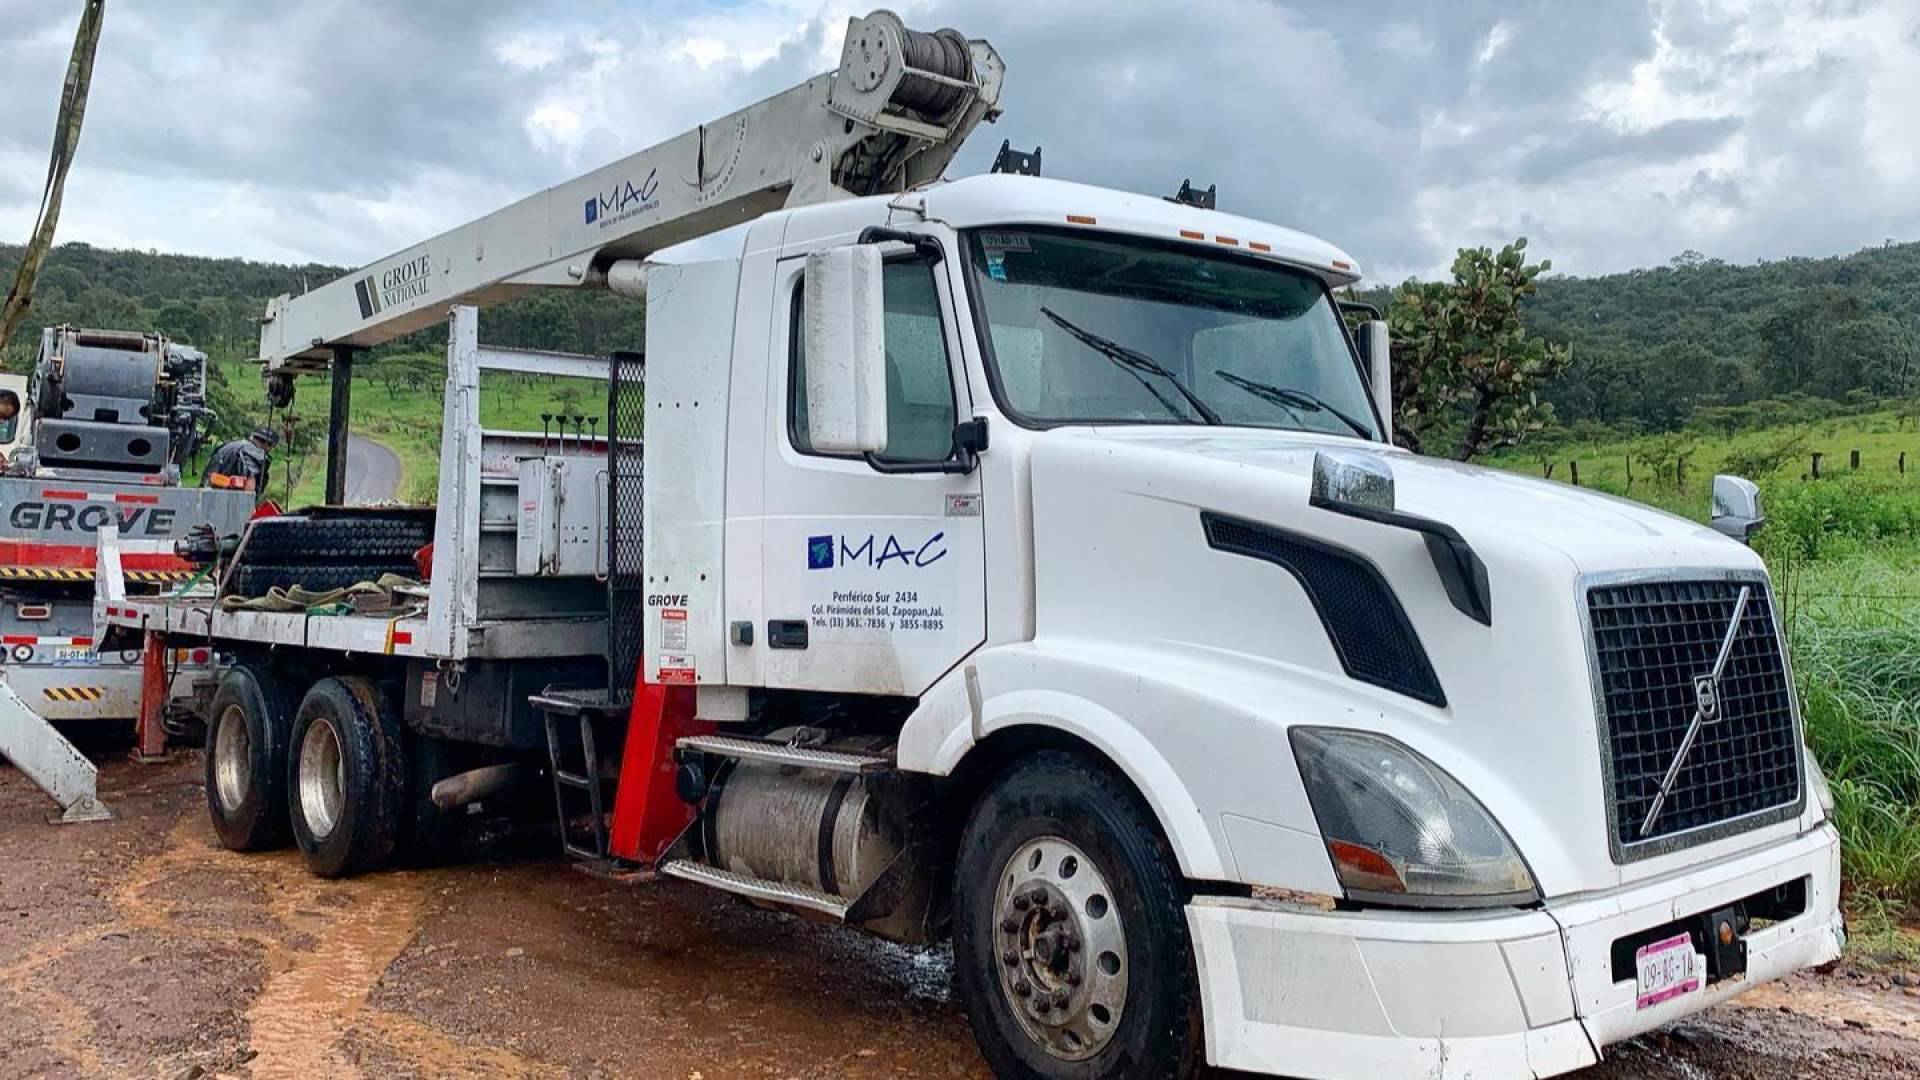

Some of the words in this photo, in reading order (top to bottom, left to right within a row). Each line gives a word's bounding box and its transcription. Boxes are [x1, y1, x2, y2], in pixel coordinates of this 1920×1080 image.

[599, 168, 659, 219] MAC
[383, 254, 430, 290] GROVE
[383, 278, 430, 307] NATIONAL
[10, 501, 176, 535] GROVE
[840, 532, 948, 570] MAC
[647, 594, 688, 607] GROVE
[862, 605, 875, 616] del
[875, 591, 890, 603] Sur
[895, 591, 918, 603] 2434
[890, 621, 896, 632] y
[900, 619, 944, 631] 3855-8895
